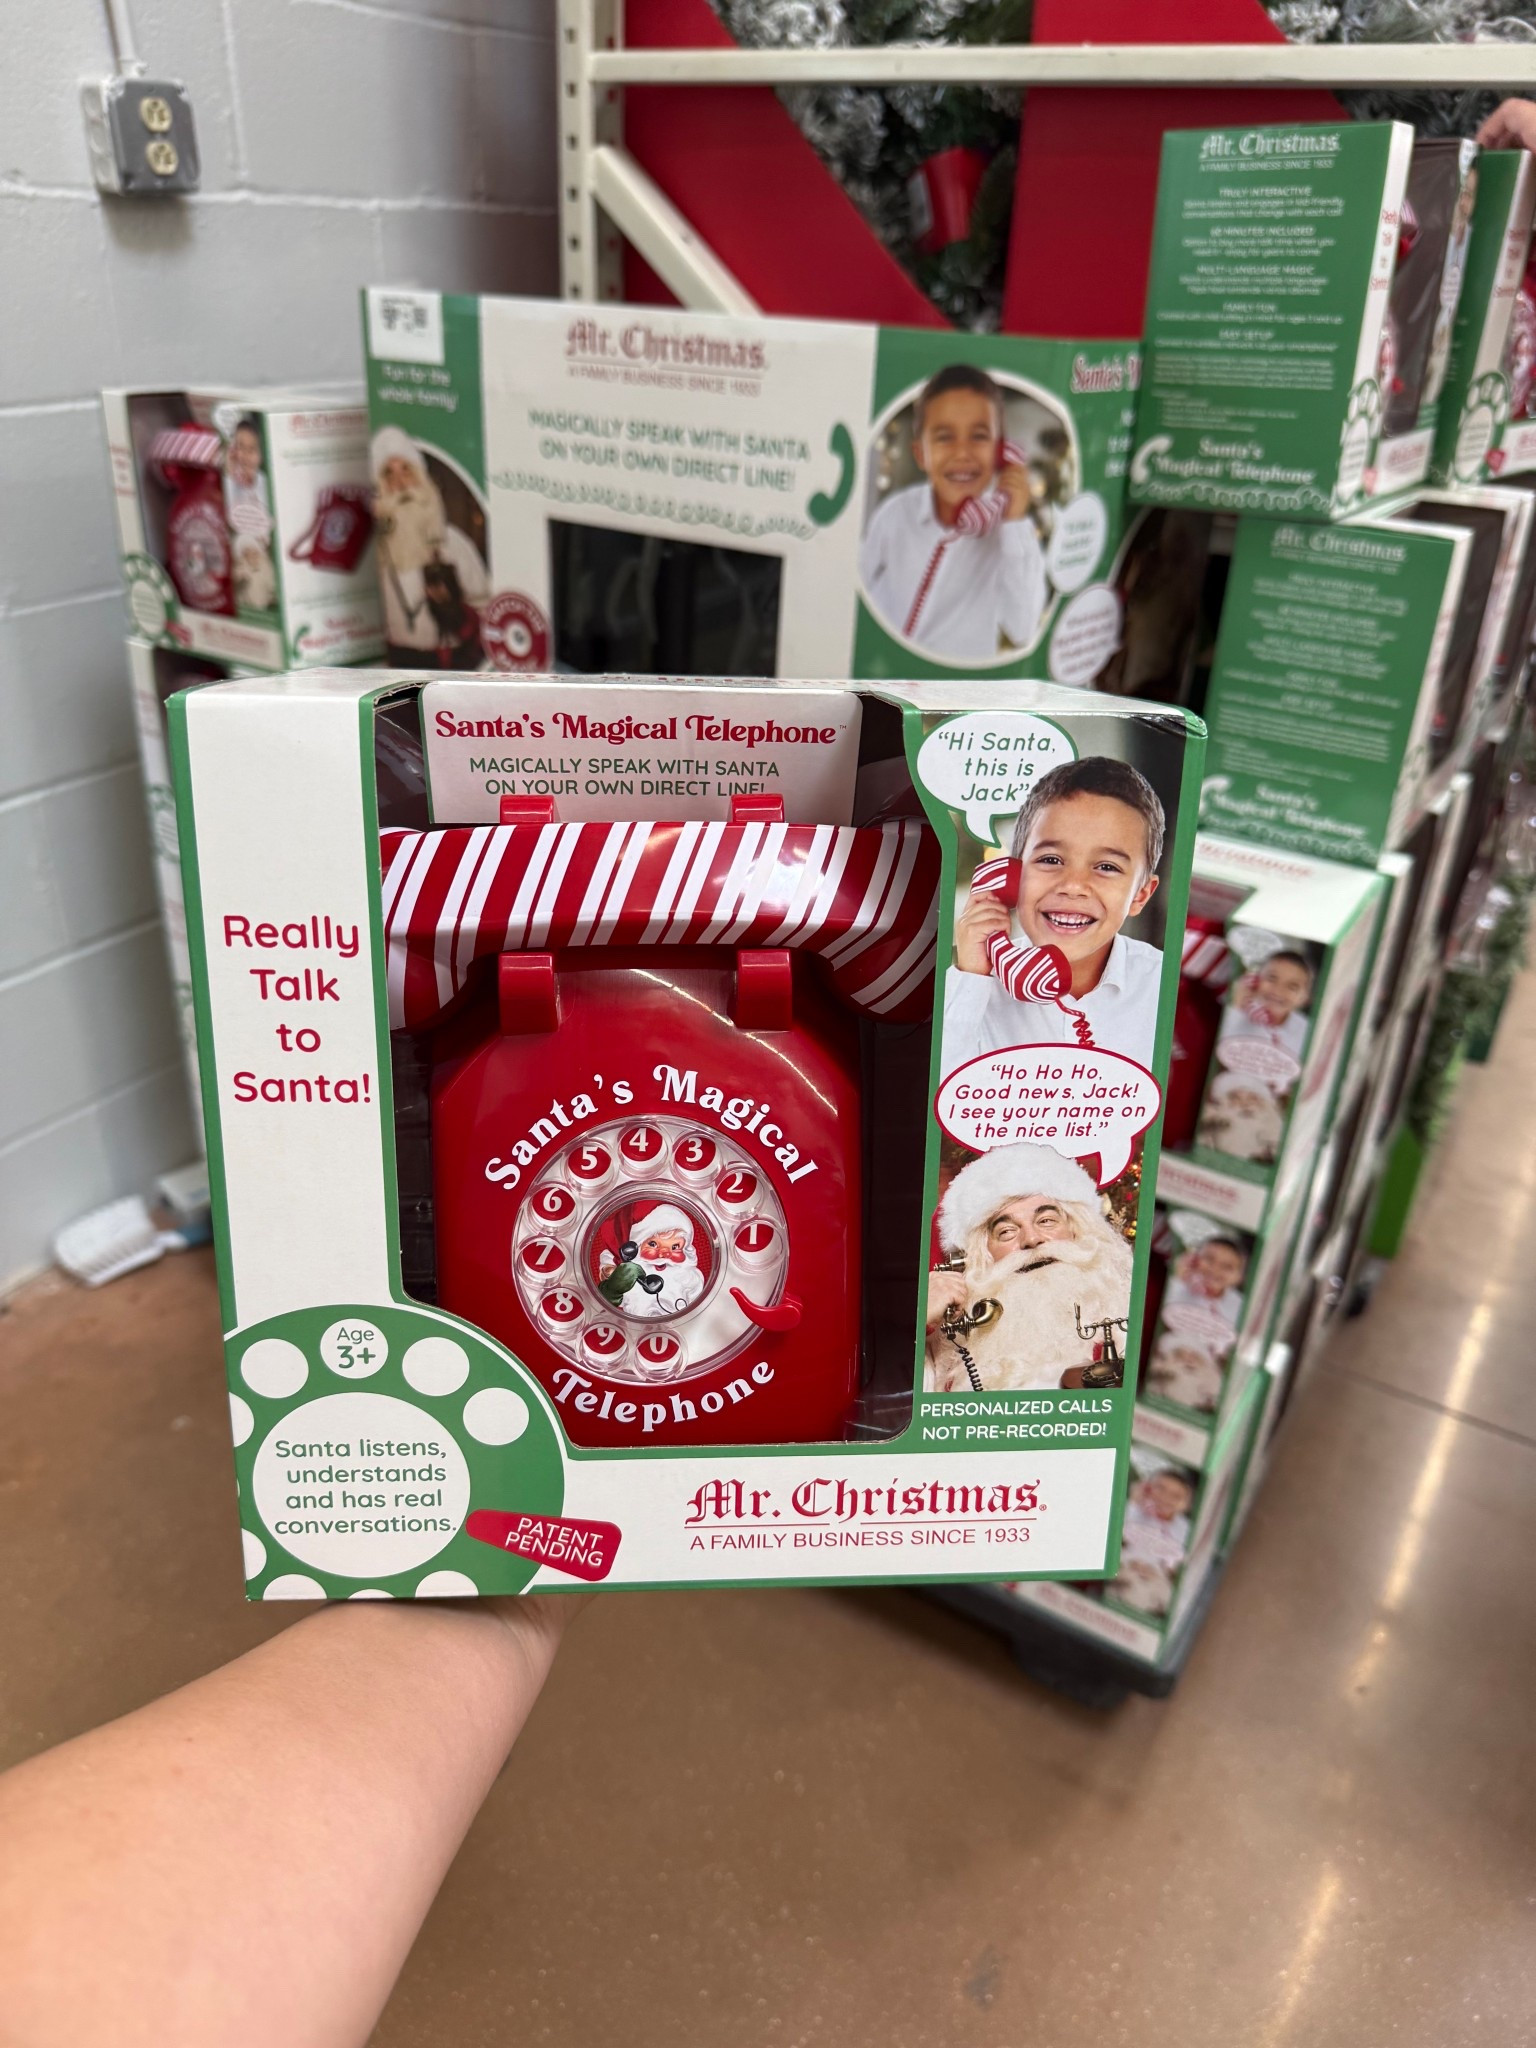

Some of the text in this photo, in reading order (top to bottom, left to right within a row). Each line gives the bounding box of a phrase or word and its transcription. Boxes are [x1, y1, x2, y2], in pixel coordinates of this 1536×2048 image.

[528, 409, 810, 462] MAGICALLY SPEAK WITH SANTA
[538, 437, 567, 460] ON
[570, 442, 620, 467] YOUR
[623, 448, 669, 474] OWN
[671, 455, 741, 483] DIRECT
[435, 711, 545, 740] Santa's
[552, 713, 677, 744] Magical
[981, 732, 1056, 753] Santa,
[469, 757, 780, 777] MAGICALLY SPEAK WITH SANTA
[965, 757, 1035, 777] this is
[485, 779, 766, 797] ON YOUR OWN DIRECT LINE!
[224, 915, 359, 958] Really
[249, 968, 340, 1001] Talk
[276, 1024, 321, 1052] to
[1036, 1065, 1063, 1080] Ho
[1072, 1064, 1103, 1081] Ho,
[233, 1071, 370, 1104] Santa!
[955, 1083, 1139, 1100] Good news, Jack!
[652, 1064, 819, 1184] Magical
[949, 1104, 1146, 1122] I see your name on
[628, 1127, 650, 1152] 4
[975, 1123, 1008, 1138] the
[1015, 1122, 1058, 1138] nice
[581, 1147, 599, 1171] 5
[686, 1138, 704, 1163] 3
[726, 1172, 744, 1194] 2
[542, 1188, 563, 1212] 6
[748, 1223, 758, 1245] 1
[534, 1241, 554, 1266] 7
[554, 1291, 575, 1314] 8
[336, 1327, 374, 1344] Age
[596, 1327, 616, 1347] 9
[650, 1337, 668, 1355] 0
[337, 1345, 376, 1369] 3+
[552, 1361, 775, 1433] Telephone
[920, 1399, 1112, 1417] PERSONALIZED CALLS
[922, 1422, 1107, 1440] NOT PRE-RECORDED!
[275, 1439, 447, 1458] Santa listens,
[286, 1464, 447, 1483] understands
[285, 1489, 442, 1509] and has real
[684, 1478, 781, 1525] Mr.
[274, 1515, 457, 1535] conversations.
[517, 1518, 603, 1549] PATENT
[505, 1532, 604, 1567] PENDING
[690, 1527, 1031, 1551] A FAMILY BUSINESS SINCE 1933
